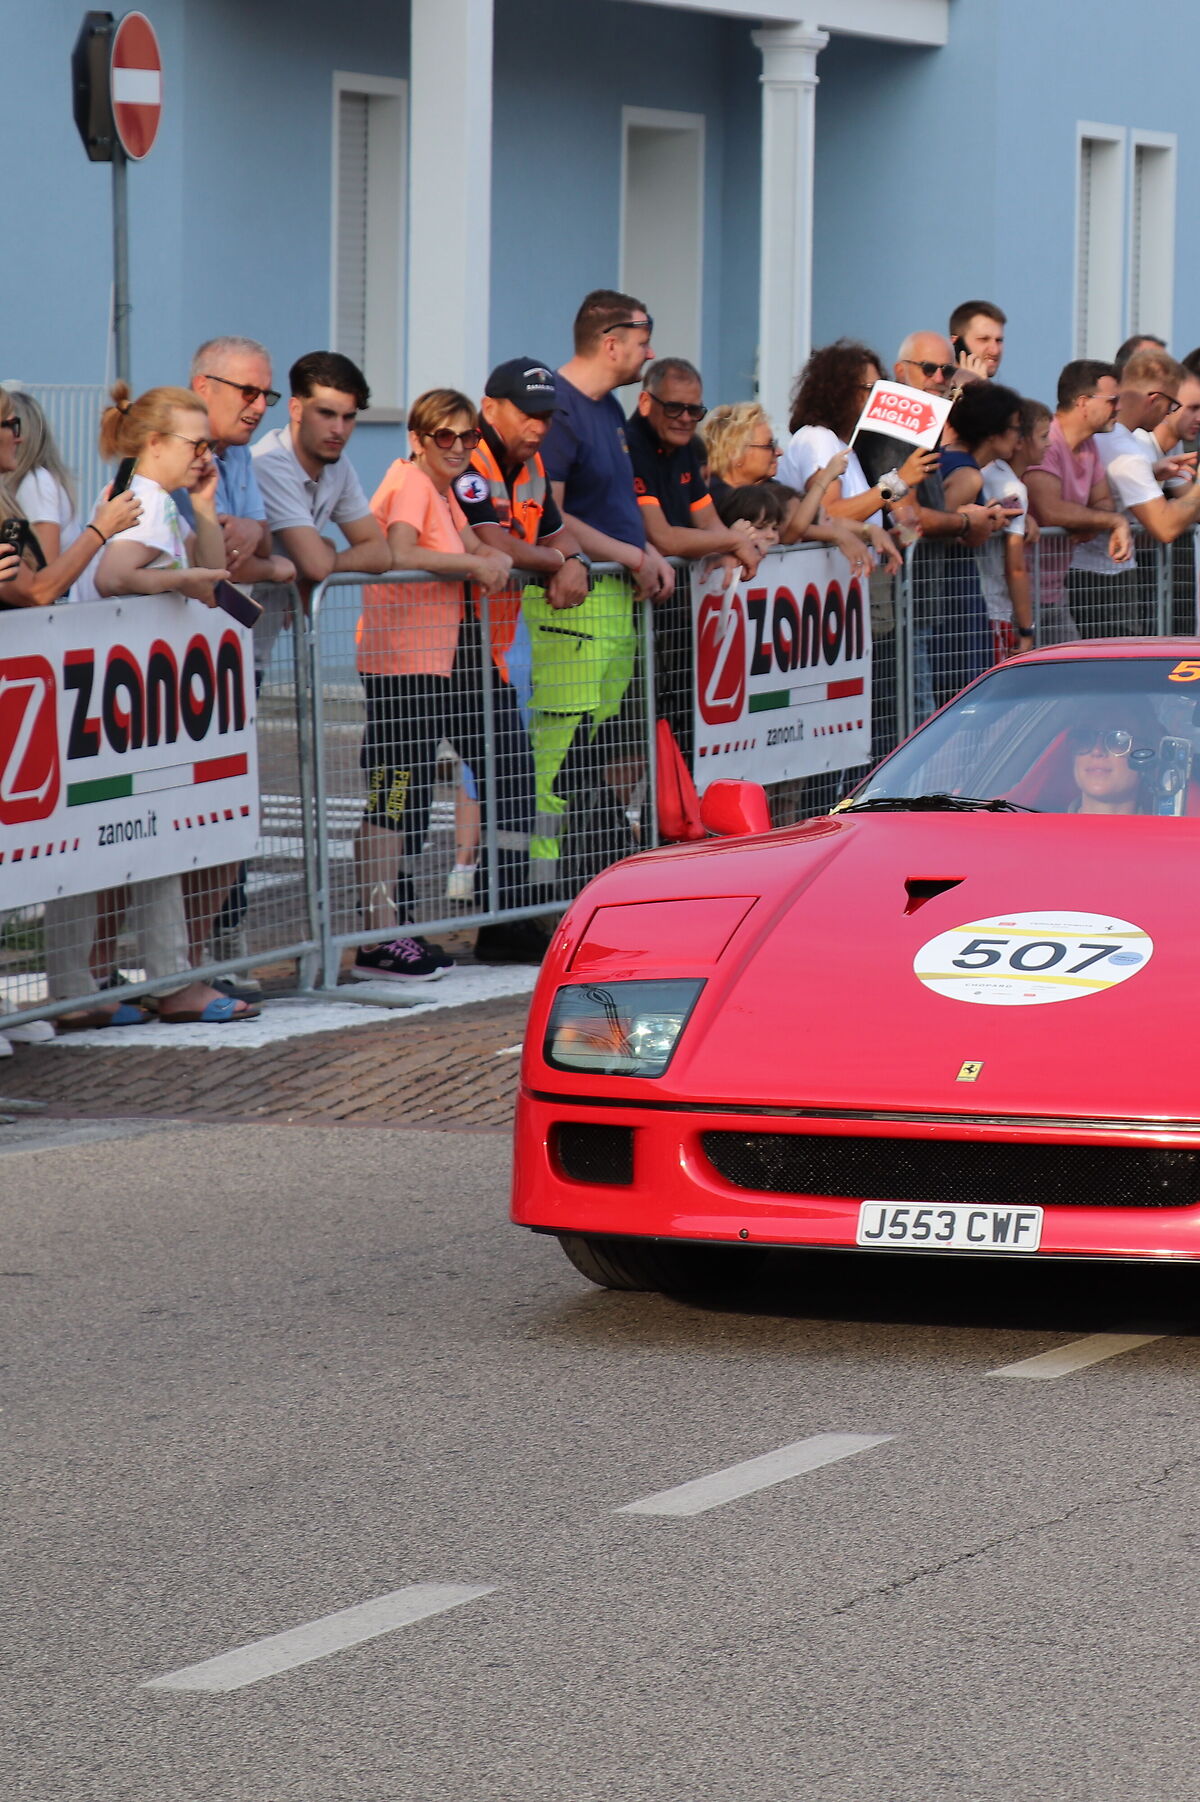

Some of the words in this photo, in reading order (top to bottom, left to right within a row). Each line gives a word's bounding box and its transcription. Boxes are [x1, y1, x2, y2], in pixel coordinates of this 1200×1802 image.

[870, 406, 921, 430] MIGLIA
[880, 394, 923, 415] 1000
[747, 576, 864, 676] zanon
[63, 628, 246, 760] zanon
[767, 719, 804, 746] zanon.it
[98, 810, 157, 846] zanon.it
[952, 938, 1123, 974] 507
[865, 1208, 956, 1241] J553
[967, 1211, 1036, 1244] CWF
